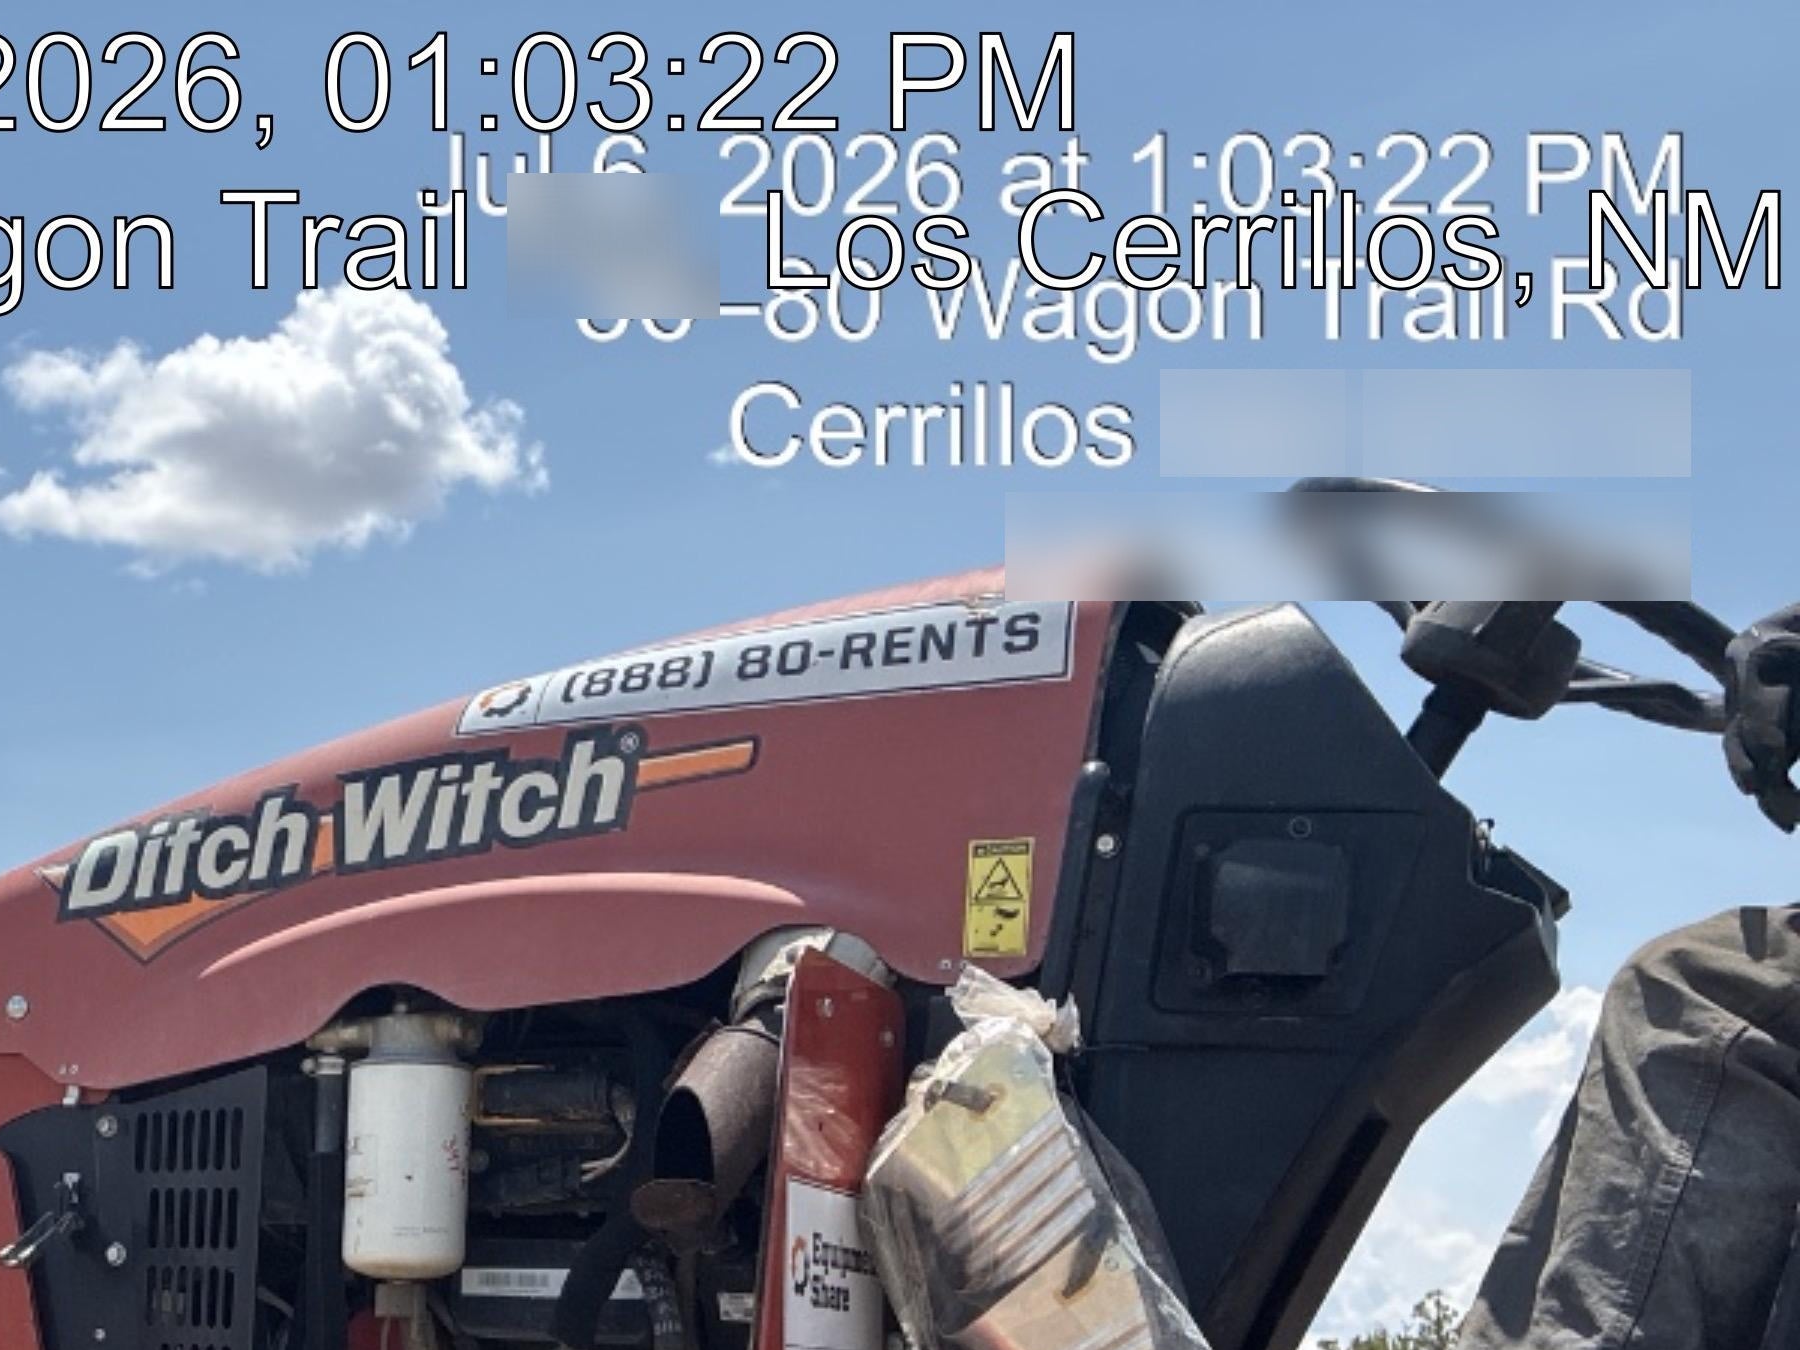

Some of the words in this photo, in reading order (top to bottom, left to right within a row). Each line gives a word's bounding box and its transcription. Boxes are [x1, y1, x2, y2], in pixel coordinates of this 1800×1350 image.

[561, 650, 714, 703] (888)
[736, 612, 1041, 681] 80-RENTS
[68, 791, 310, 910] Ditch
